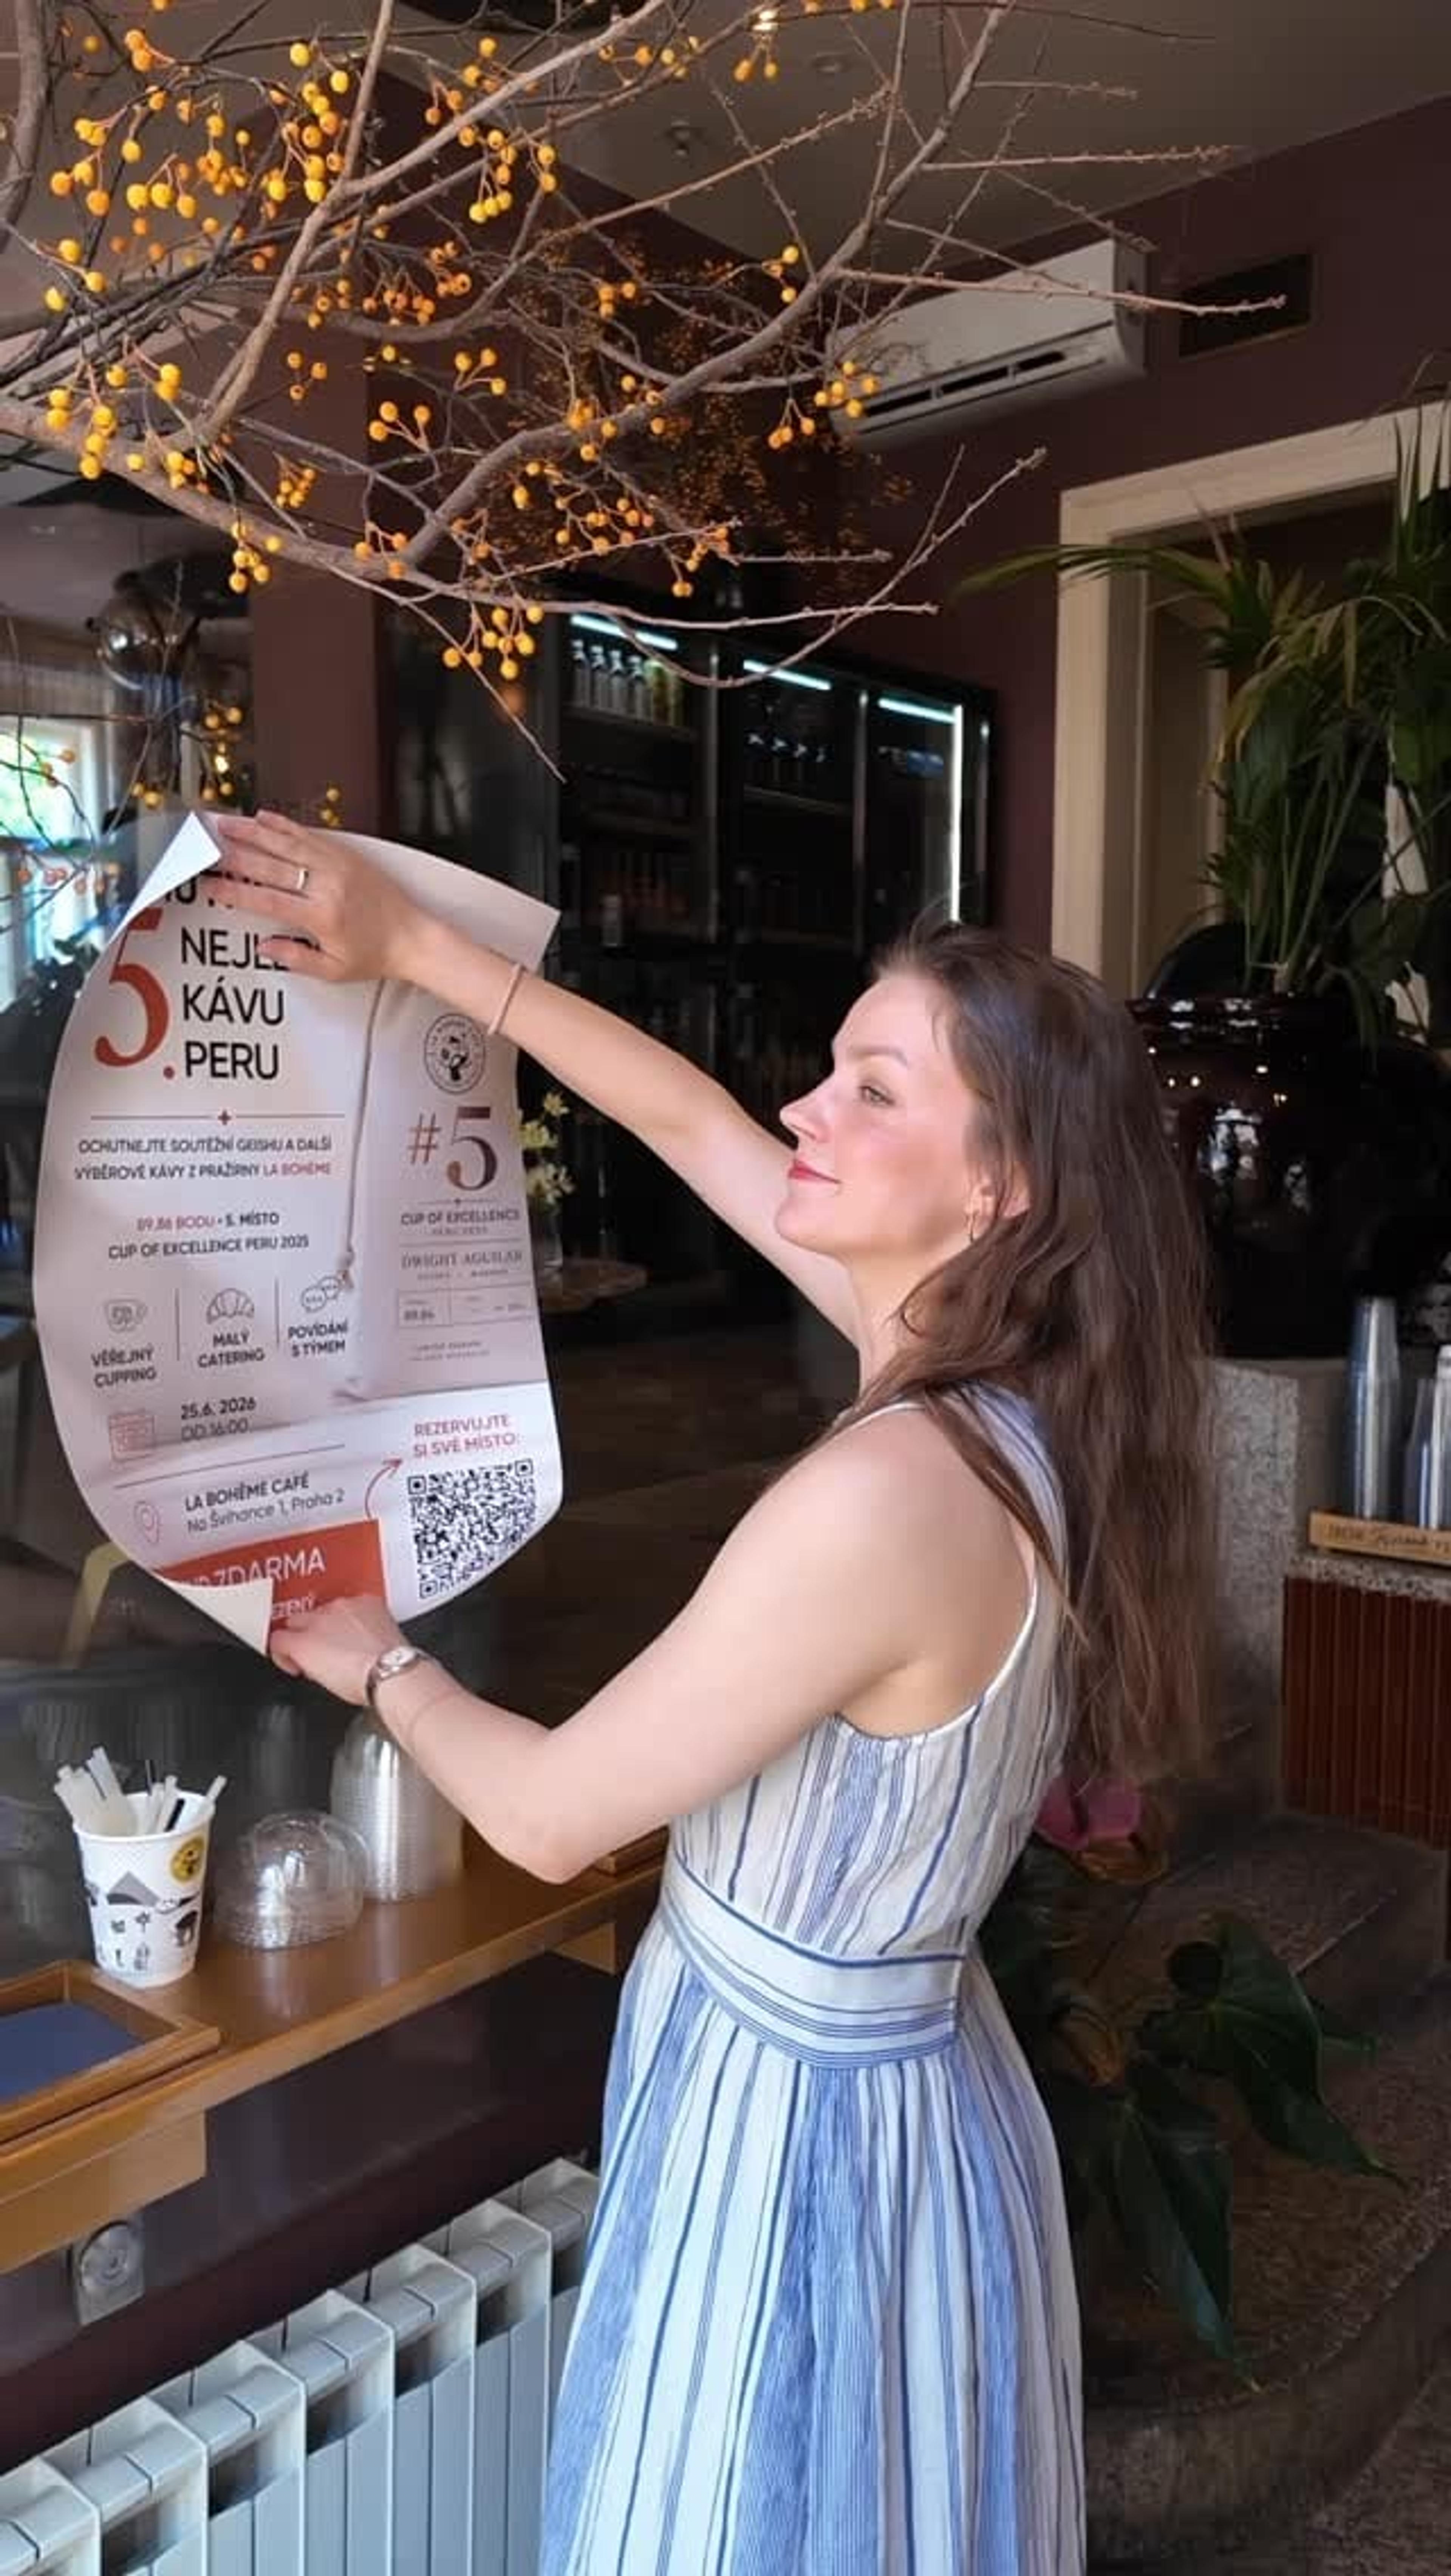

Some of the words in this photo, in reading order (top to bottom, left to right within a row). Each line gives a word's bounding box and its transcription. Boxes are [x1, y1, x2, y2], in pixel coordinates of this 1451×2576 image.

[181, 927, 320, 971] NEJL
[183, 976, 284, 1026] KÁVU
[184, 1041, 279, 1080] PERU
[79, 1139, 169, 1153] OCHUTNEJTE
[171, 1135, 234, 1152] SOUTĚŽNÍ
[236, 1138, 283, 1151] GEISHU
[286, 1139, 294, 1150] A
[297, 1135, 332, 1151] DALŠÍ
[407, 1106, 498, 1191] #5
[75, 1164, 145, 1180] VÝBĚROVÉ
[149, 1164, 184, 1179] KÁVY
[189, 1166, 196, 1178] Z
[200, 1161, 259, 1177] PRAŽÍRNY
[263, 1164, 277, 1175] LA
[240, 1209, 280, 1226] MÍSTO
[401, 1213, 424, 1225] CUP
[428, 1212, 443, 1224] OF
[447, 1209, 520, 1223] EXCELLENCE
[109, 1244, 137, 1259] CUP
[141, 1243, 159, 1257] OF
[163, 1238, 243, 1256] EXCELLENCE
[246, 1237, 278, 1252] PERU
[281, 1234, 309, 1248] 2025
[213, 1327, 249, 1348] MALÝ
[288, 1317, 348, 1339] POVÍDÁNÍ
[198, 1348, 266, 1368] CATERING
[292, 1344, 300, 1358] S
[303, 1339, 345, 1356] TÝMEM
[94, 1366, 157, 1387] CUPPING
[181, 1425, 207, 1442] OD
[414, 1415, 509, 1437] REZERVUJTE
[413, 1444, 427, 1458] SI
[431, 1437, 460, 1455] SVÉ
[185, 1495, 203, 1512] LA
[271, 1472, 309, 1494] CAFÉ
[189, 1519, 207, 1533] Na
[292, 1491, 332, 1511] Praha
[336, 1488, 345, 1503] 2
[213, 1547, 326, 1584] ZDARMA
